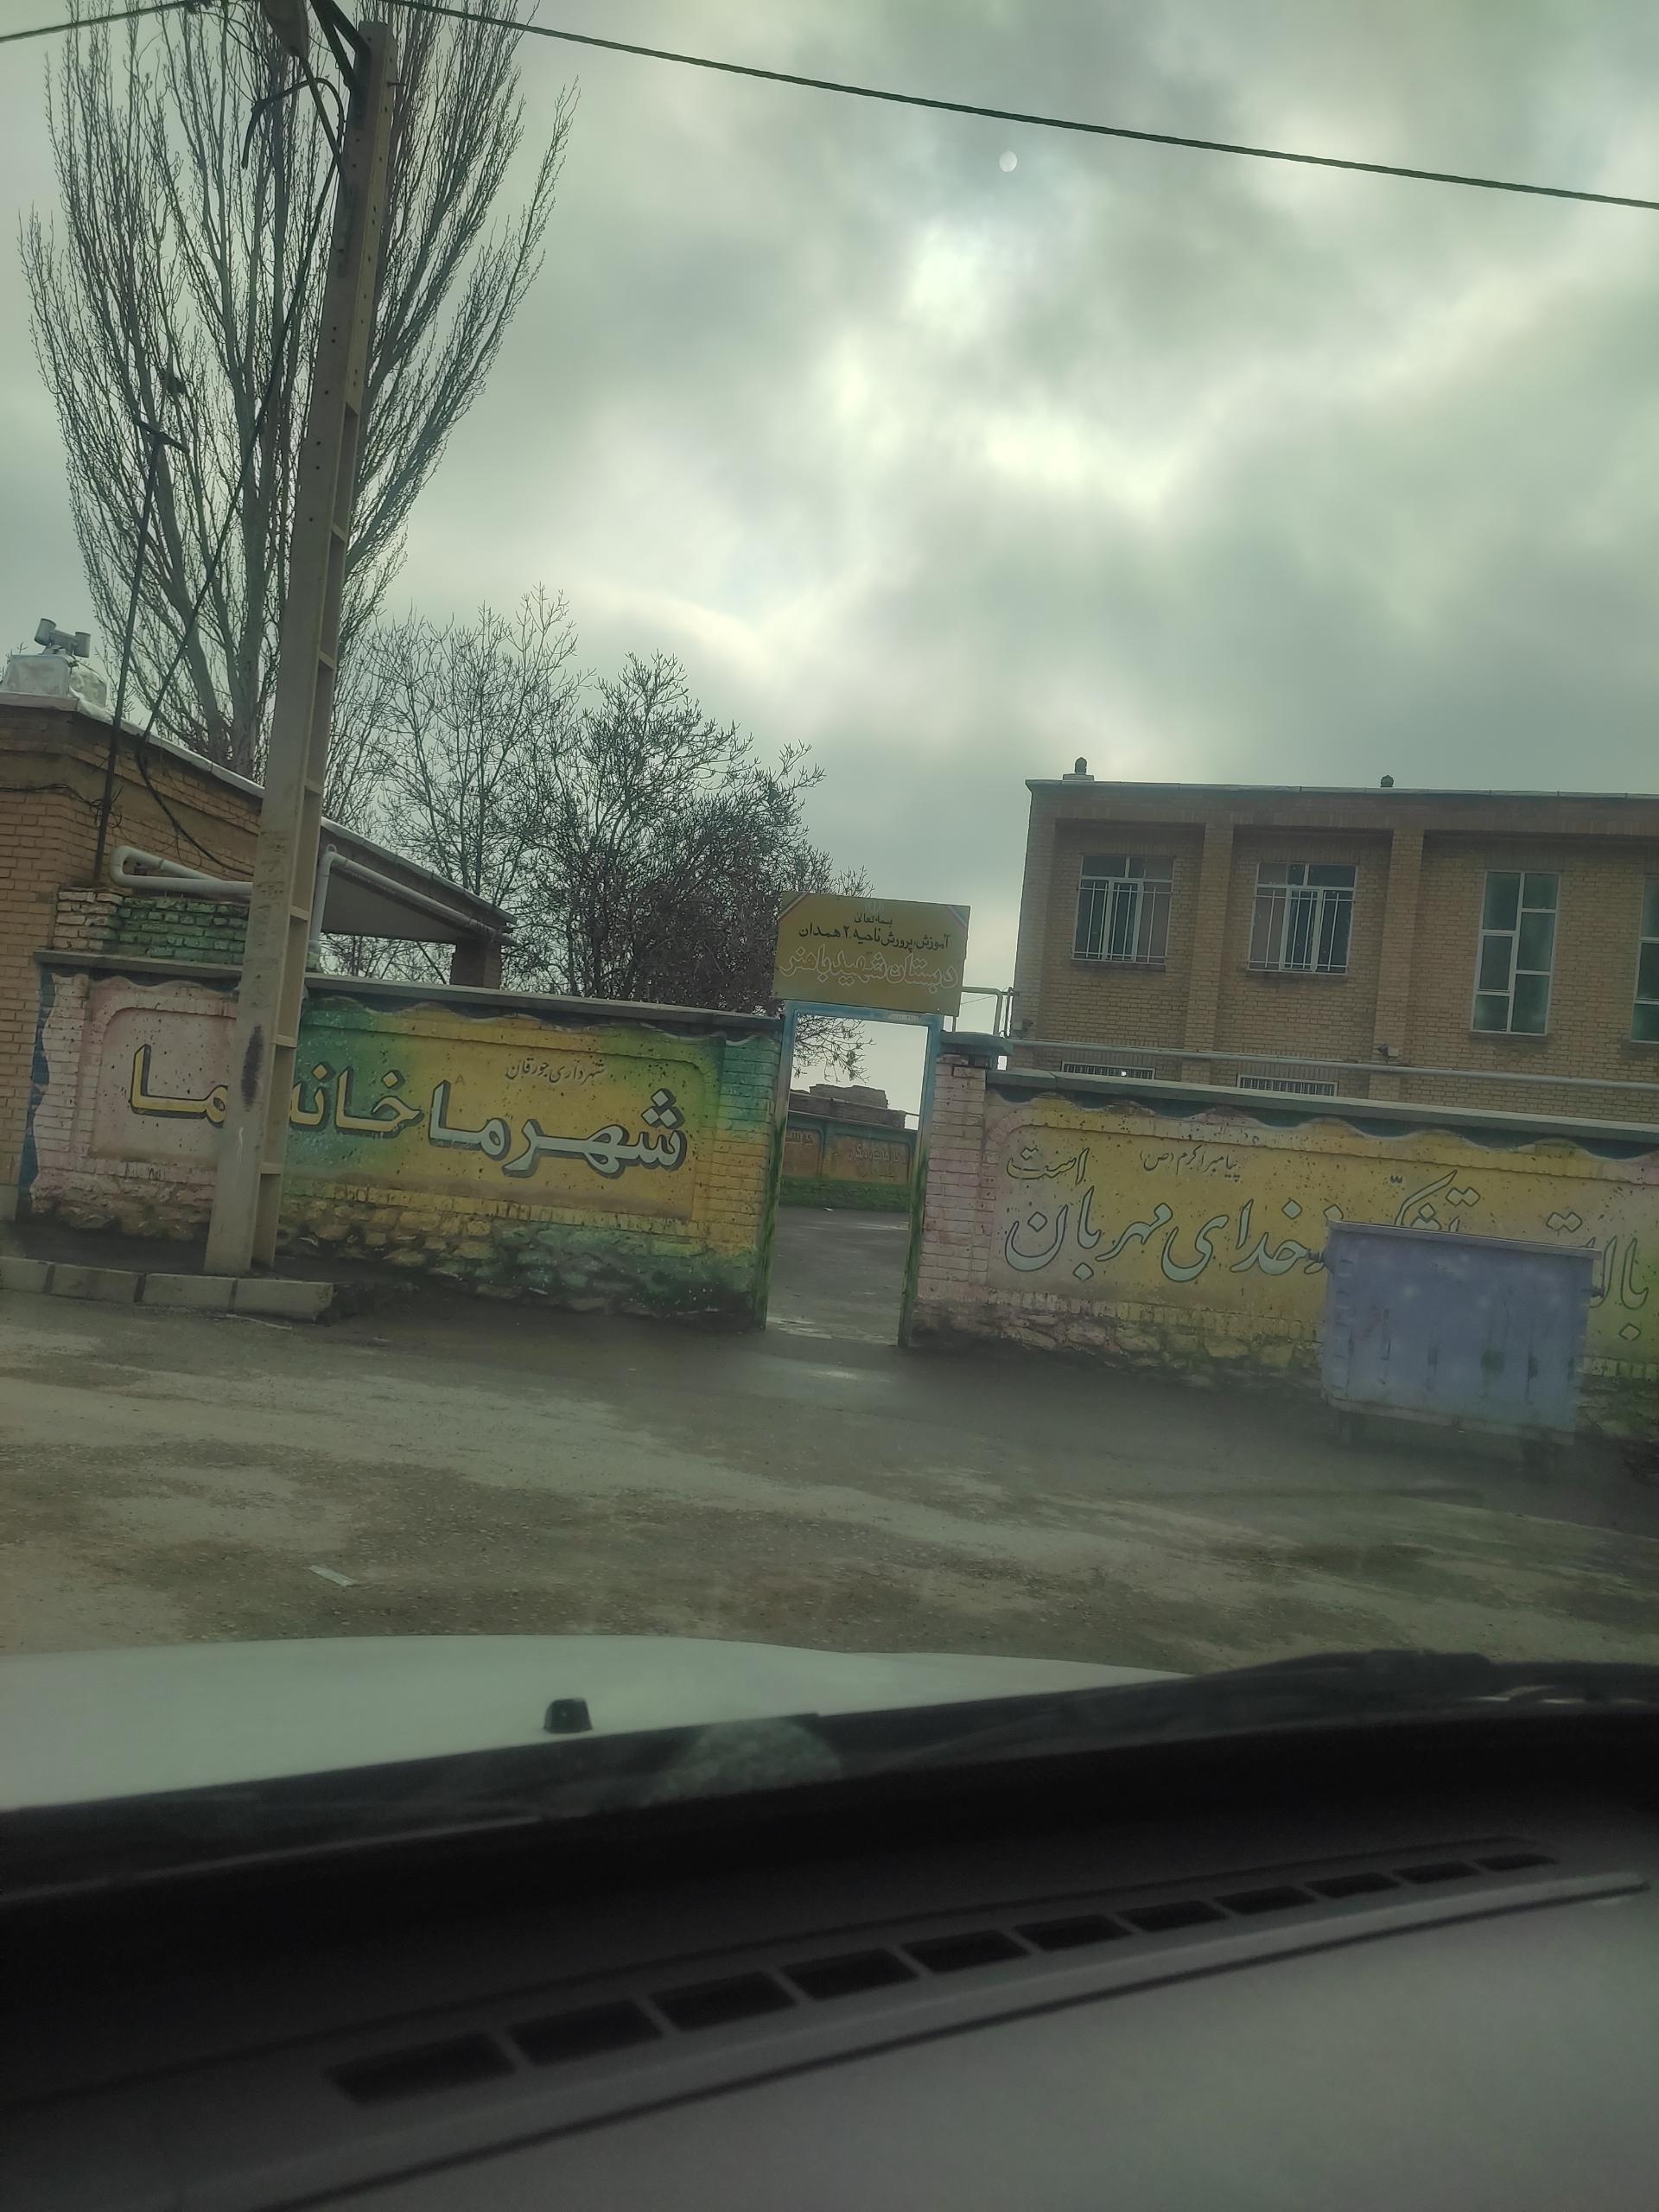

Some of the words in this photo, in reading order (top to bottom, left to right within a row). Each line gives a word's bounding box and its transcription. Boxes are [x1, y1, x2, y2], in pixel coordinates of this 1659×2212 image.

[798, 922, 841, 938] همدان
[853, 927, 881, 944] ناحیه
[880, 931, 913, 953] پرورش
[916, 933, 951, 950] آموزش
[779, 944, 830, 982] باهنر
[830, 950, 887, 986] شهید
[886, 951, 958, 995] دبستان
[130, 1043, 229, 1129] ما
[505, 1058, 550, 1080] جورقان
[549, 1058, 607, 1085] شهرداری
[289, 1060, 425, 1140] خان
[428, 1080, 511, 1160] ما
[501, 1087, 688, 1179] شهر
[1006, 1146, 1090, 1185] است
[1175, 1143, 1205, 1177] اکرم
[1199, 1154, 1242, 1183] پیامبر
[1004, 1185, 1174, 1282] مهربان
[1160, 1198, 1309, 1283] خدای
